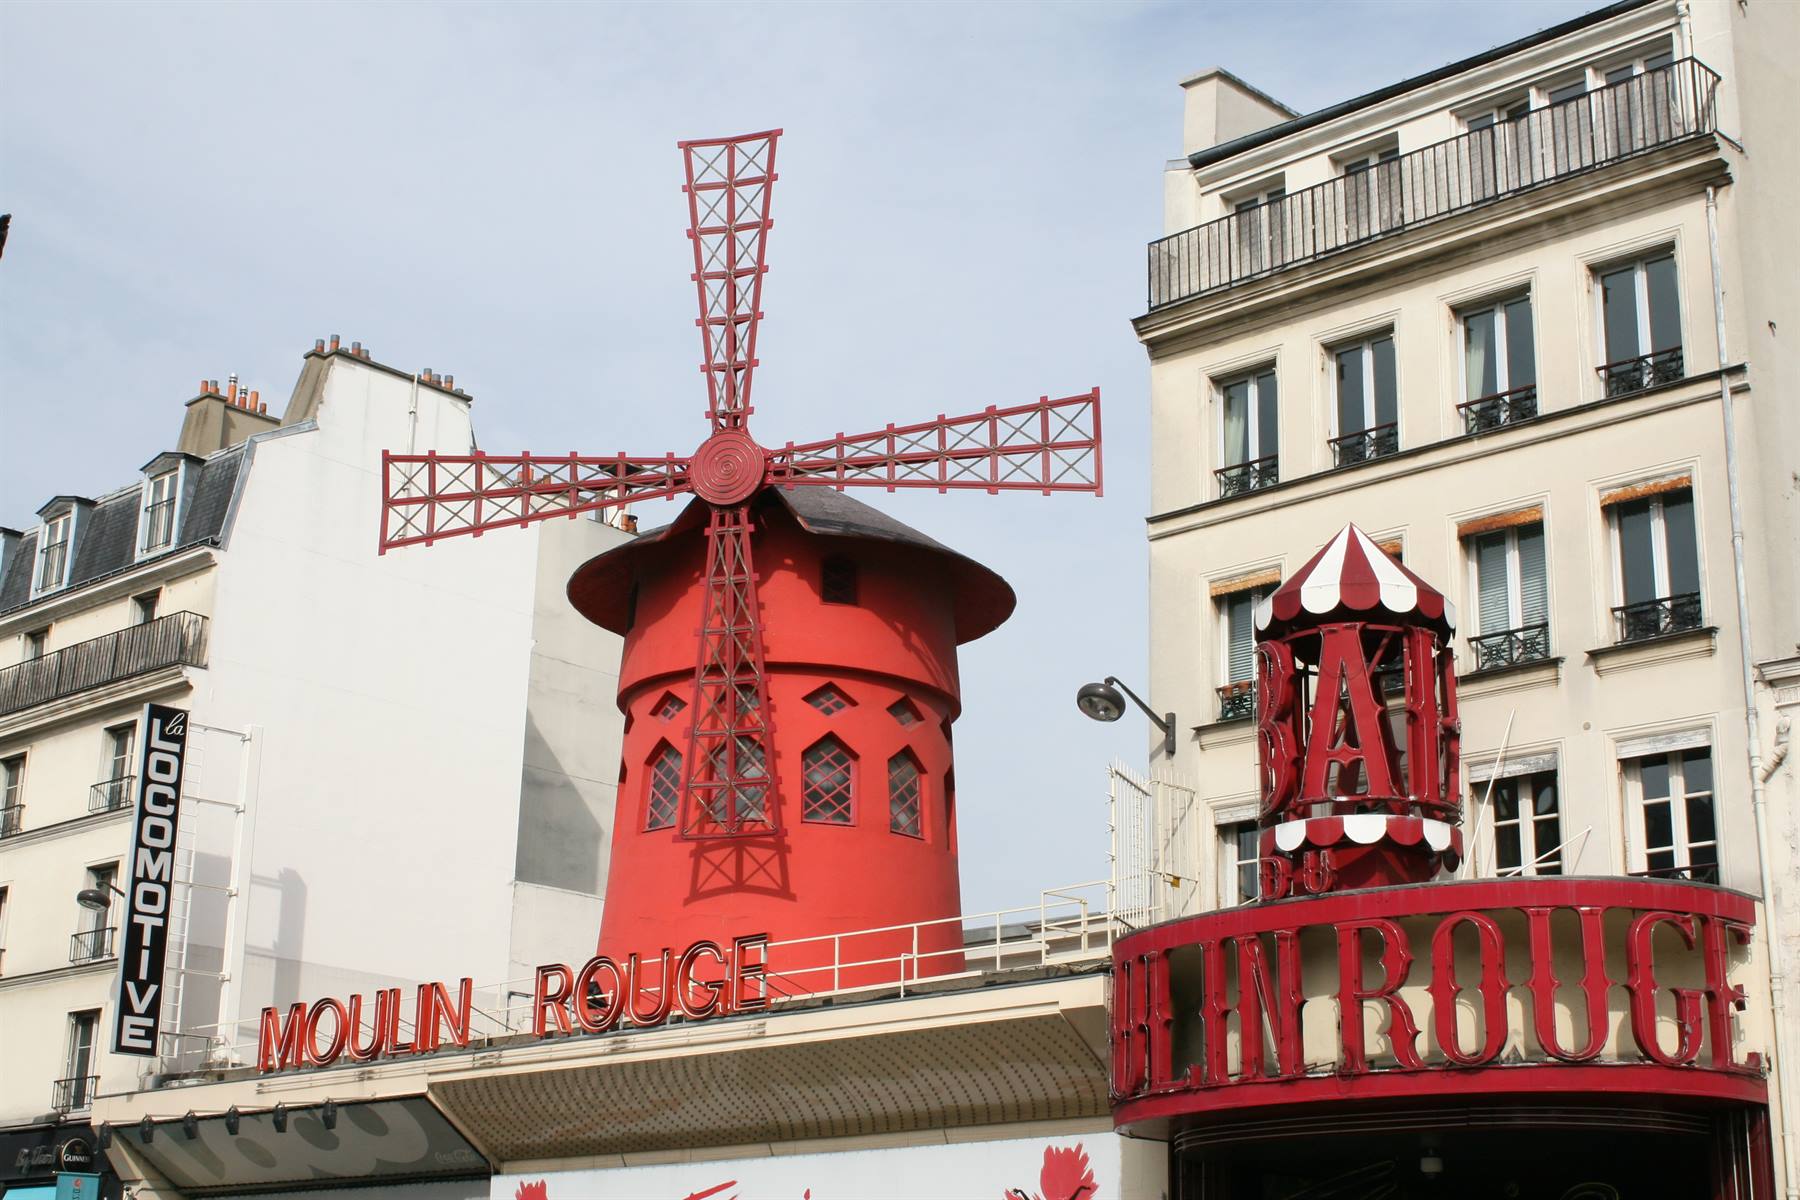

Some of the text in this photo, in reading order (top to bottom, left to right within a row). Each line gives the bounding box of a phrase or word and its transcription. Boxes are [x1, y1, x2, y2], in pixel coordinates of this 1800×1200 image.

[165, 712, 185, 736] la
[1257, 621, 1464, 825] BAL
[121, 717, 181, 1049] LOCOMOTIVE
[1259, 849, 1338, 901] DU
[256, 932, 771, 1075] MOULIN ROUGE
[1328, 905, 1766, 1078] ROUGE
[63, 1153, 91, 1163] GUINN
